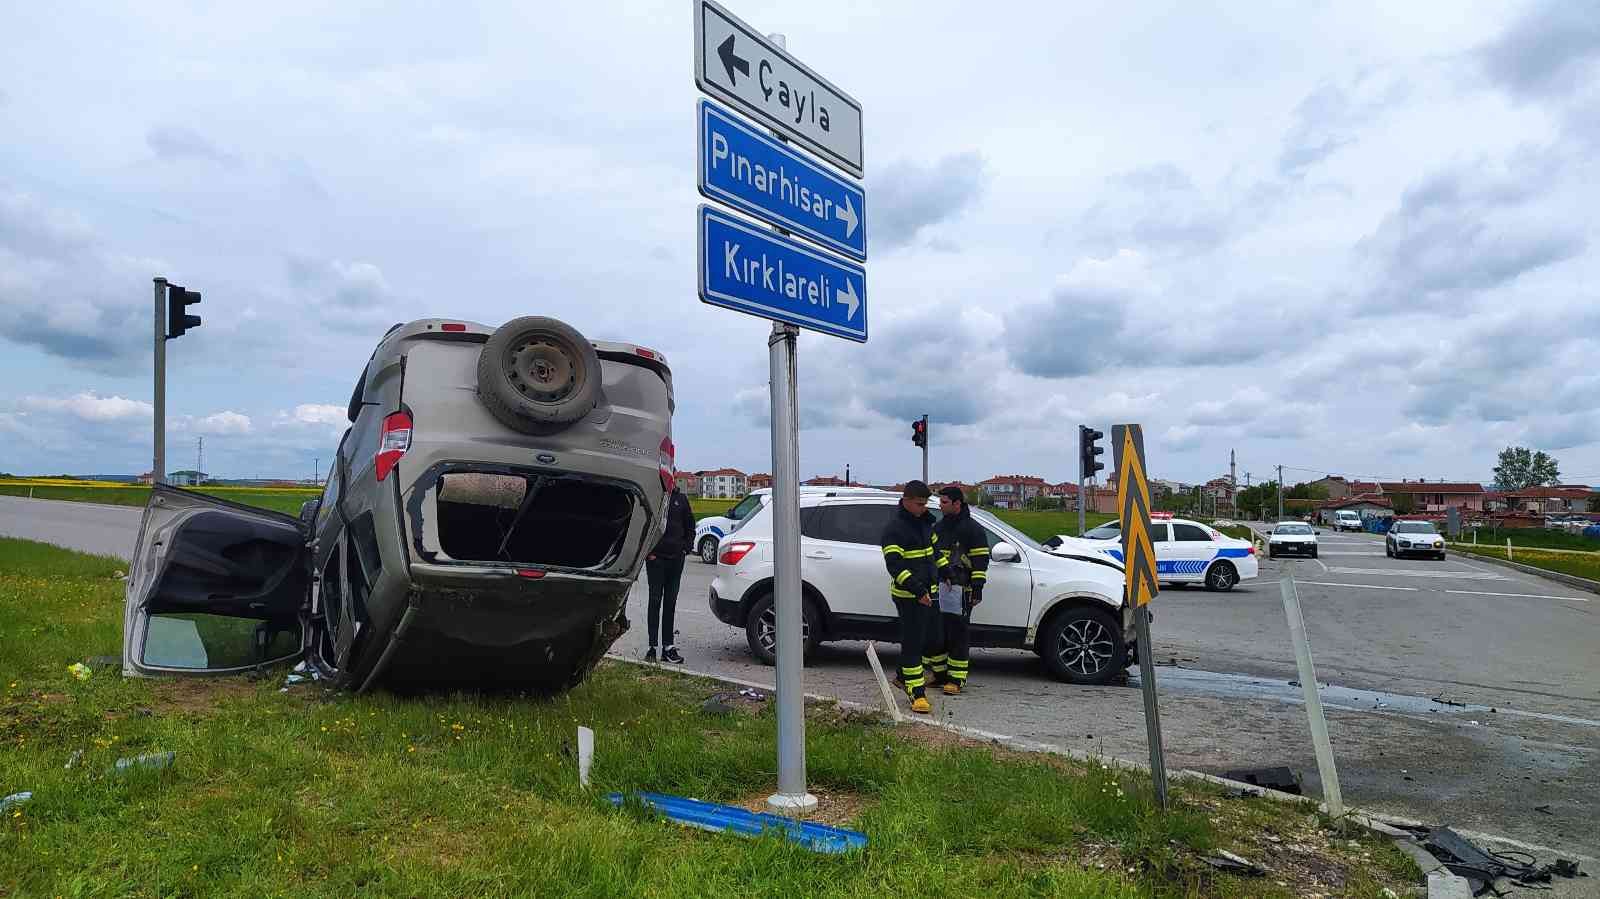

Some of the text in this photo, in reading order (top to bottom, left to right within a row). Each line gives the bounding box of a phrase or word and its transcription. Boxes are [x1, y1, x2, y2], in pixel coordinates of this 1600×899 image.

[759, 59, 830, 132] Çayla
[712, 131, 832, 221] Pınarhisar
[725, 240, 830, 308] Kırklareli
